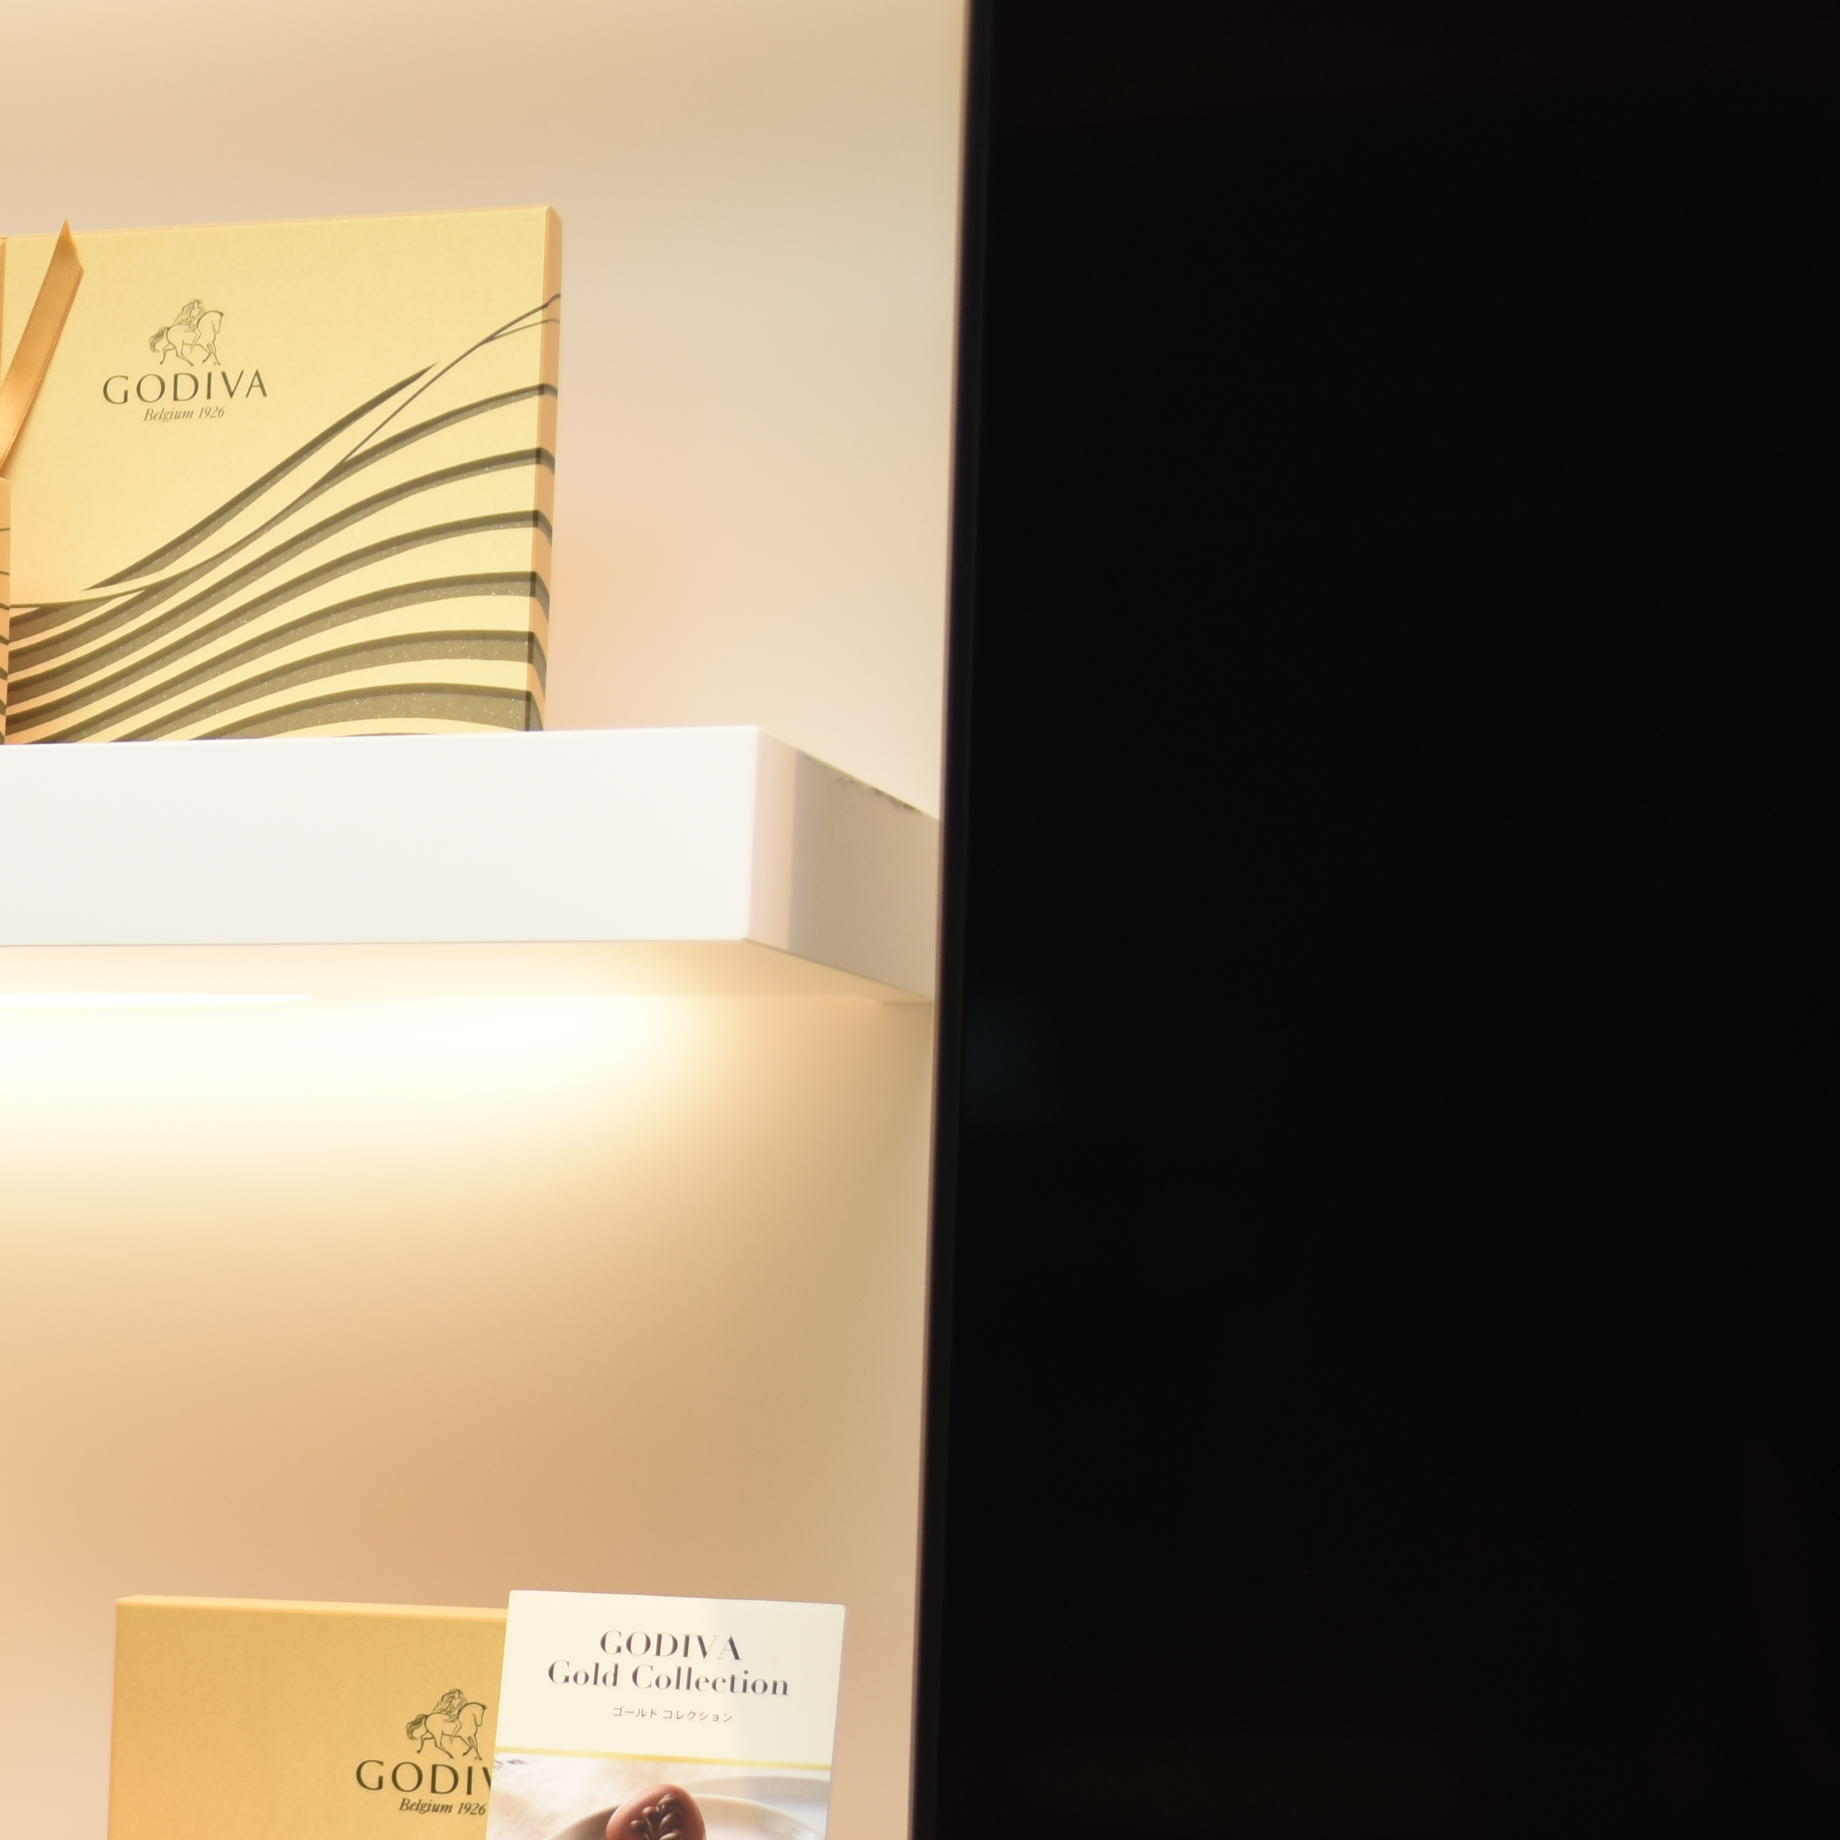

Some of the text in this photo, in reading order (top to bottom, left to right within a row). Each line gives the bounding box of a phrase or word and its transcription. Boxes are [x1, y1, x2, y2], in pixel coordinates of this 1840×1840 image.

[102, 368, 268, 405] GODIVA
[143, 405, 225, 423] Belgium 1926
[599, 1629, 742, 1662] GODIVA
[547, 1659, 790, 1696] Gold Collection
[355, 1758, 492, 1797] GODI
[399, 1797, 487, 1816] Belgium 1926
